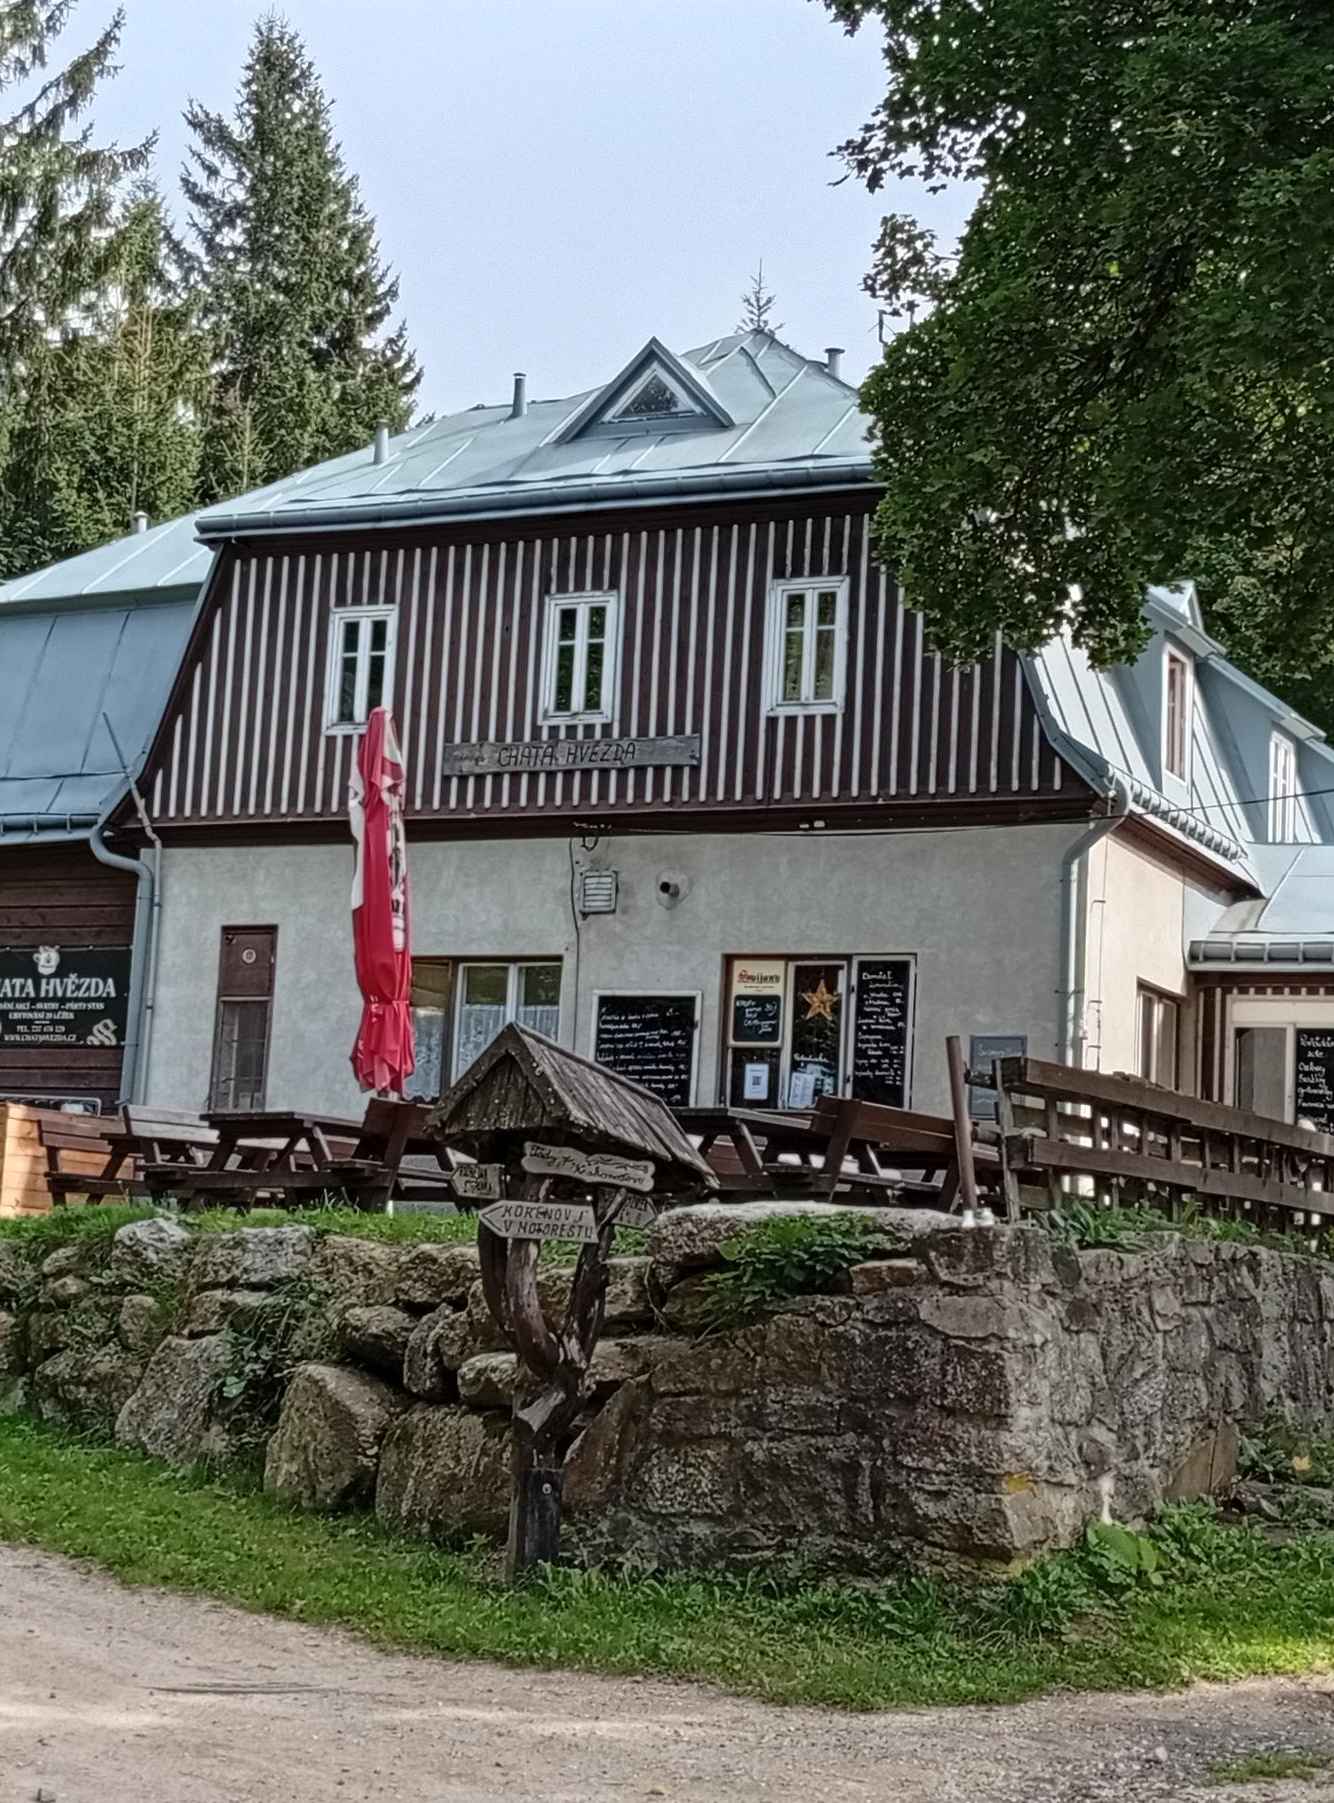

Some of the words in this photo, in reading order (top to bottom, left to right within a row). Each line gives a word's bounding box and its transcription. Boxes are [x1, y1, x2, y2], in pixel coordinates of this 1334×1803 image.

[496, 745, 555, 768] CHATA
[40, 973, 117, 998] HVĚZDA
[738, 969, 781, 984] Svijany
[503, 1219, 513, 1233] V
[518, 1220, 594, 1239] MOTORESTU
